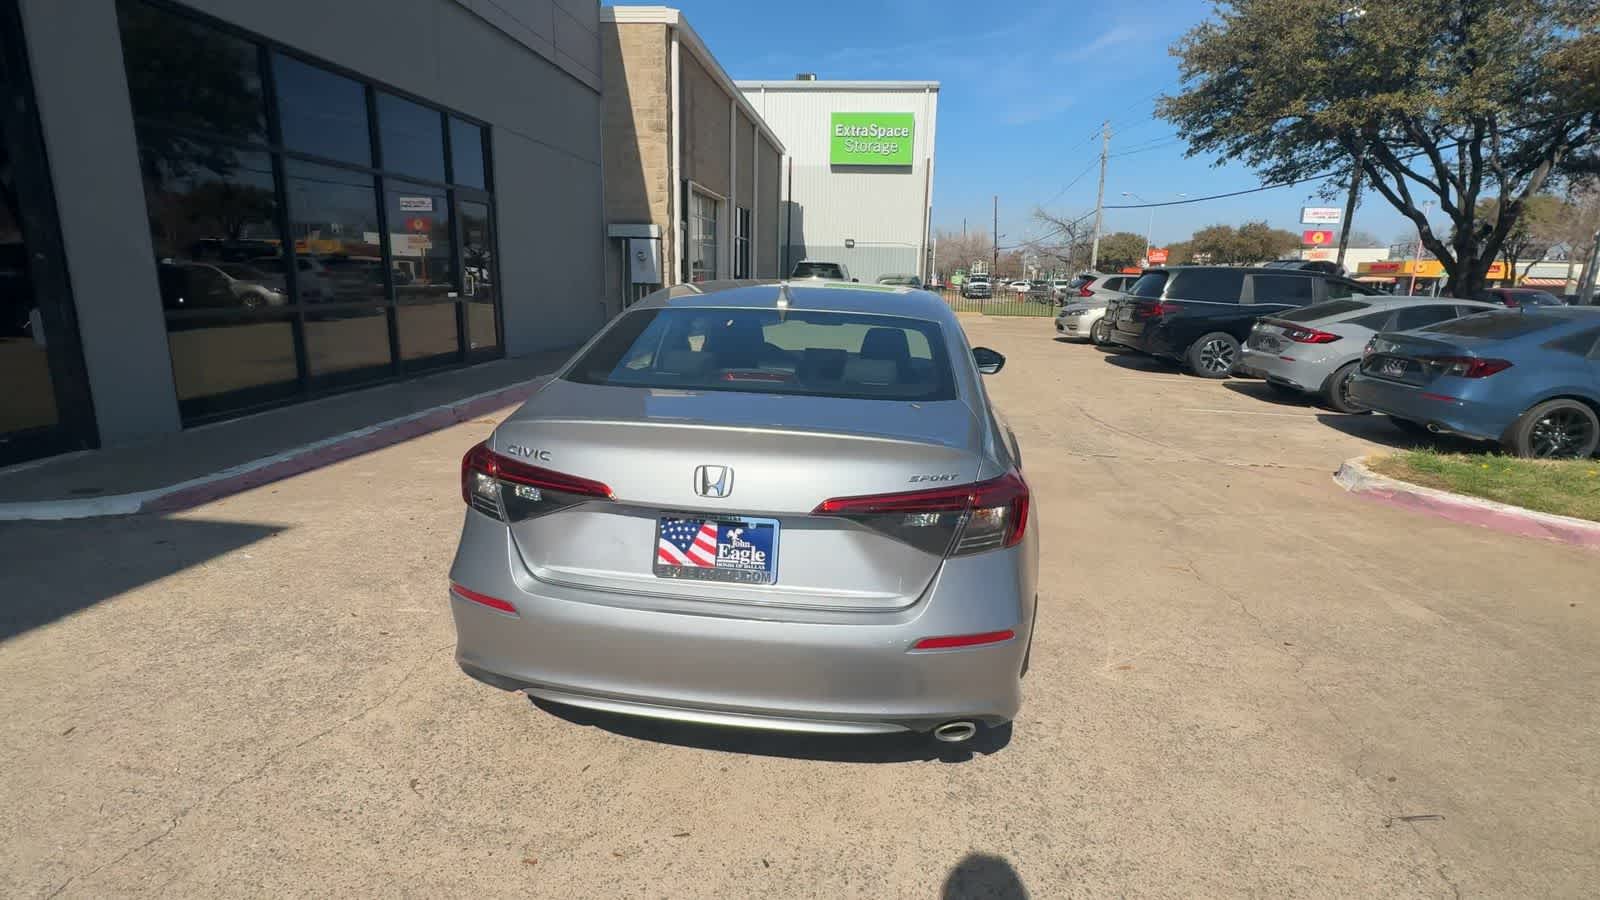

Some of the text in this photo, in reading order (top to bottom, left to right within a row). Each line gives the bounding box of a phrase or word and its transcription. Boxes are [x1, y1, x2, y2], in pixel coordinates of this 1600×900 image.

[835, 123, 909, 138] ExtraSpace
[844, 138, 899, 155] Storage
[508, 444, 552, 462] CIVIC
[908, 473, 960, 483] SPORT
[731, 539, 751, 548] John
[717, 543, 766, 565] Eagle
